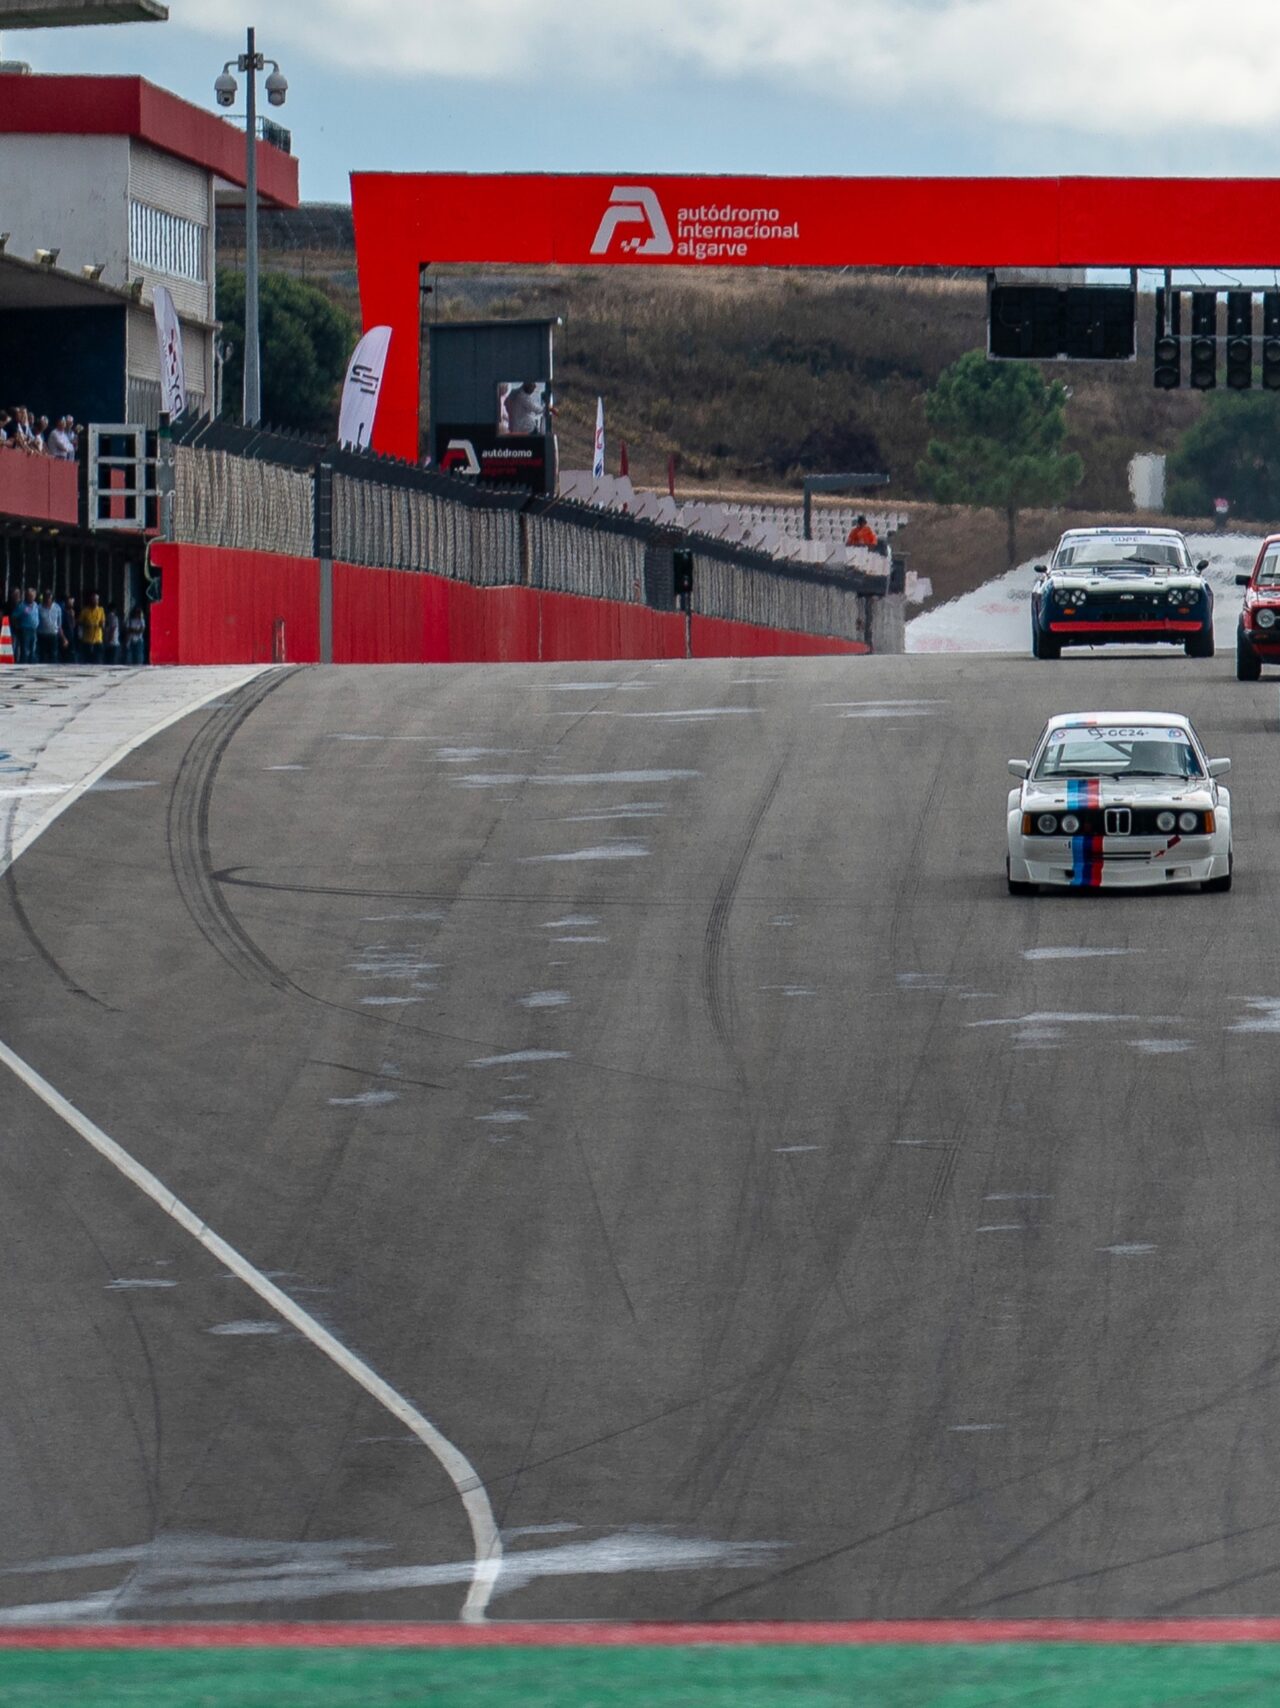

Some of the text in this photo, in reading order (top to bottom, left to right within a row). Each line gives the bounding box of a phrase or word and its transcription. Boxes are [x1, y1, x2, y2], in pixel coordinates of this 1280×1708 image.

[677, 204, 780, 222] autódromo
[677, 222, 800, 239] internacional
[677, 239, 748, 259] algarve
[481, 448, 513, 459] autódromo
